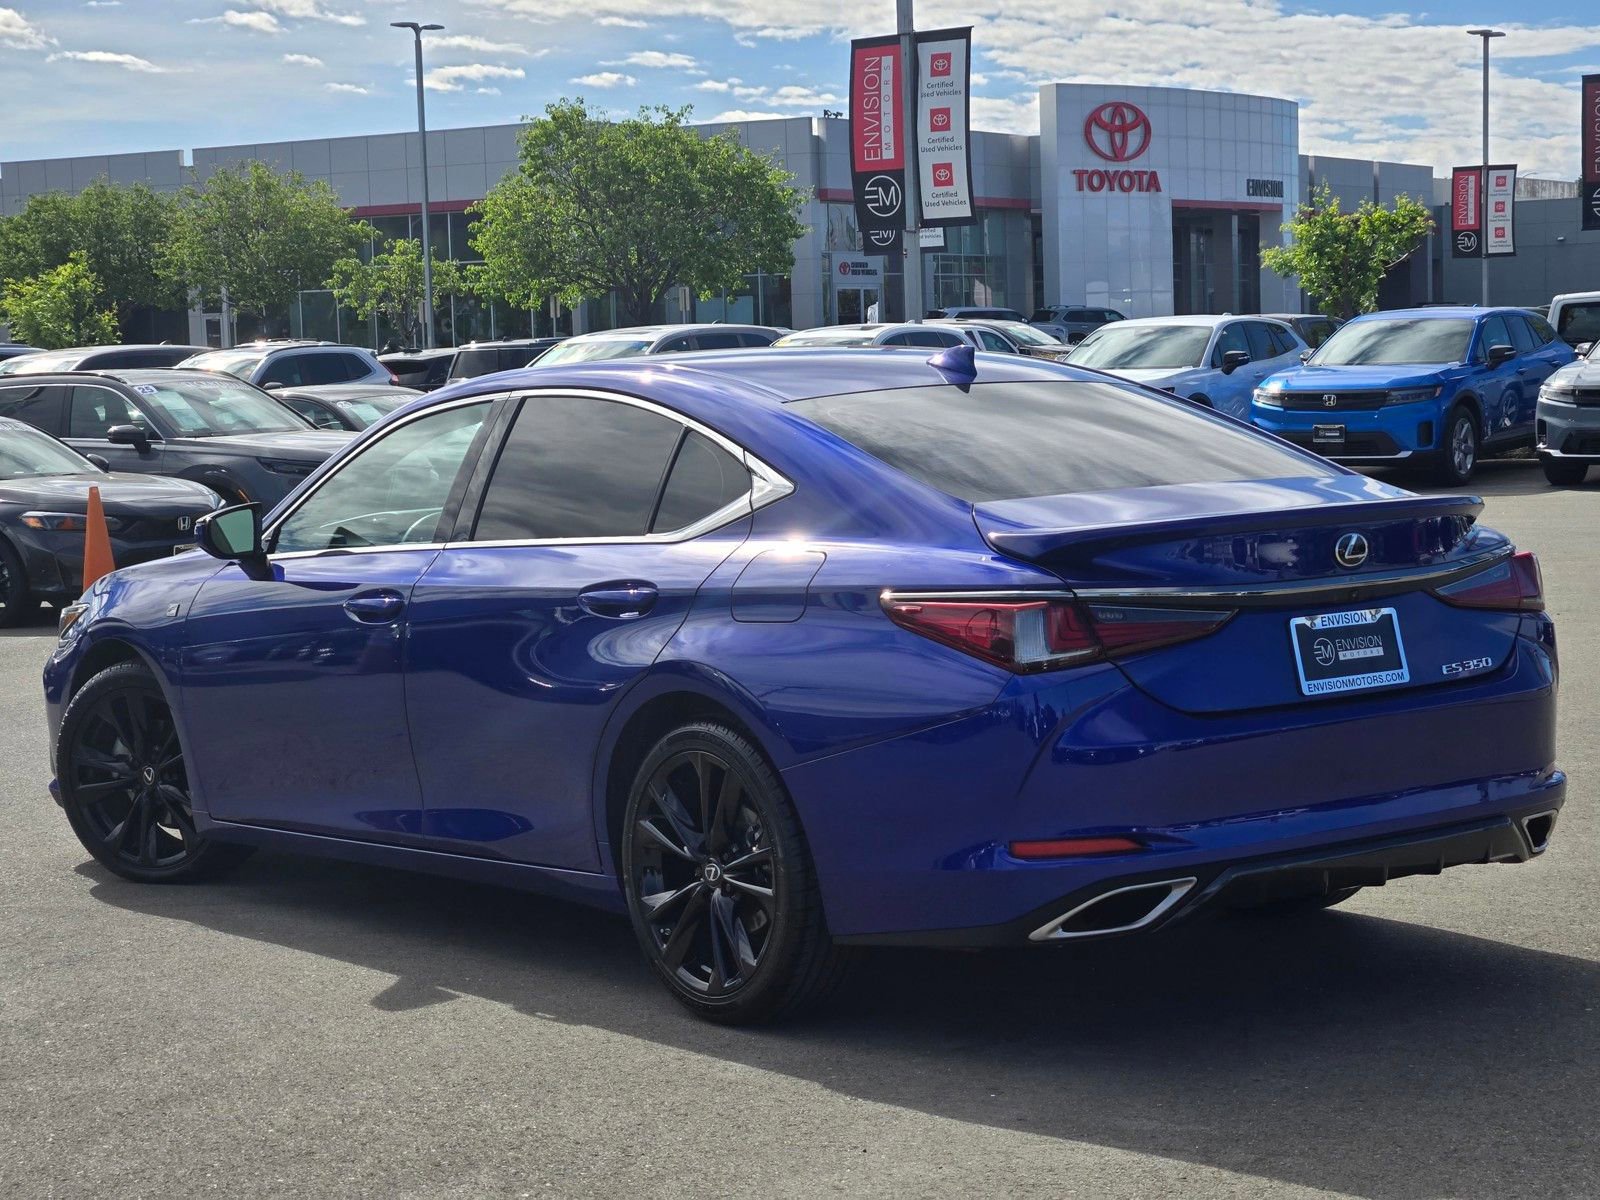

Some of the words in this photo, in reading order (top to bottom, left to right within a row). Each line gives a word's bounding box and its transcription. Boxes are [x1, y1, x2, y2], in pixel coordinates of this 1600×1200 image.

[926, 81, 954, 89] Certified
[936, 88, 962, 97] Vehicles
[863, 56, 881, 161] ENVISION
[883, 65, 892, 151] MOTORS
[920, 145, 937, 153] Used
[937, 144, 963, 152] Vehicles
[927, 136, 955, 144] Certified
[1073, 169, 1162, 193] TOYOTA
[1246, 178, 1284, 198] ENVISION
[940, 199, 967, 207] Vehicles
[1458, 175, 1468, 226] ENVISION
[1321, 611, 1368, 627] ENVISION
[1335, 635, 1383, 651] ENVISION
[1442, 662, 1463, 675] ES
[1463, 656, 1493, 671] 350
[1307, 671, 1405, 693] ENVISIONMOTORS.COM
